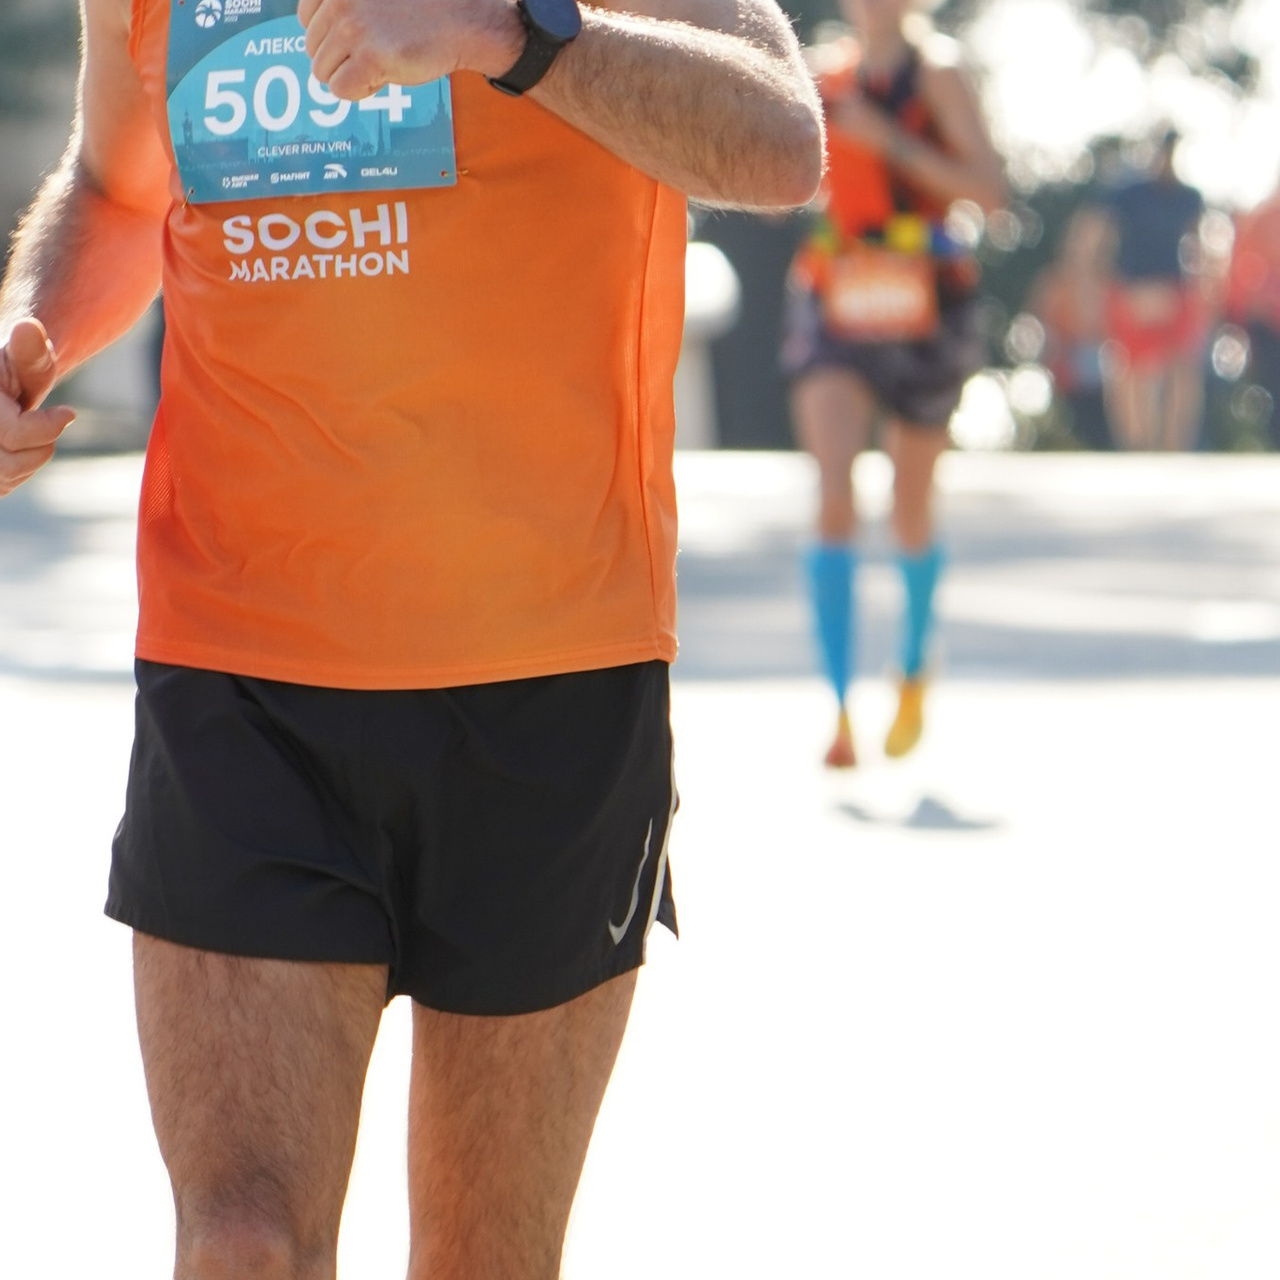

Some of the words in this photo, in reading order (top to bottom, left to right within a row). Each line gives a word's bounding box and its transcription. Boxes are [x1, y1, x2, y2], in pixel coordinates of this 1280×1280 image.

[203, 65, 412, 136] 5094
[257, 144, 300, 158] CLEVER
[301, 142, 325, 154] RUN
[328, 140, 351, 152] VRN
[223, 201, 409, 255] SOCHI
[229, 249, 410, 283] MARATHON
